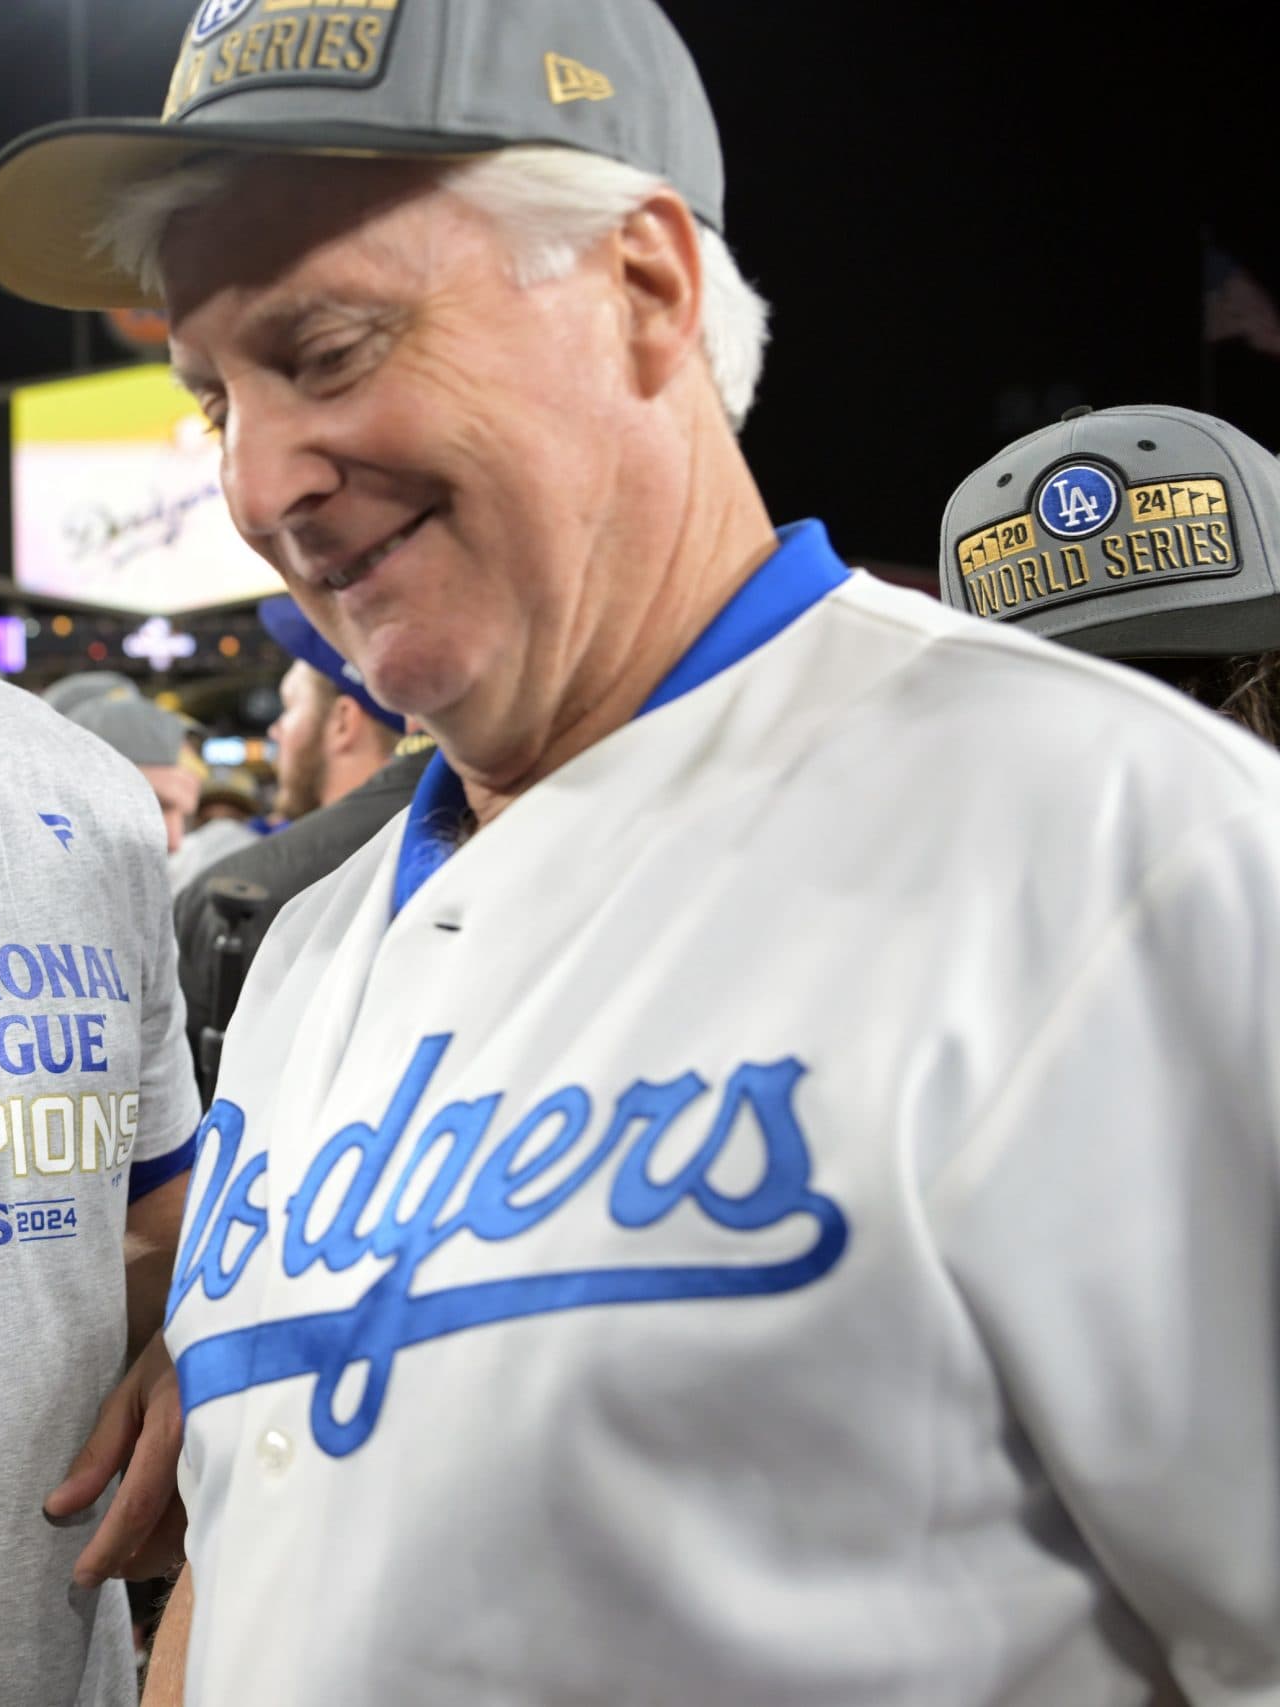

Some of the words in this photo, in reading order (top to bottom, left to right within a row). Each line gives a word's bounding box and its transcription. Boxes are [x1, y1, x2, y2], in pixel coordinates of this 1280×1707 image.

[212, 13, 382, 85] SERIES
[1053, 479, 1101, 528] LA
[1135, 488, 1167, 515] 24
[1002, 522, 1029, 549] 20
[969, 544, 1090, 618] WORLD
[1101, 520, 1233, 580] SERIES
[16, 1207, 78, 1233] 2024
